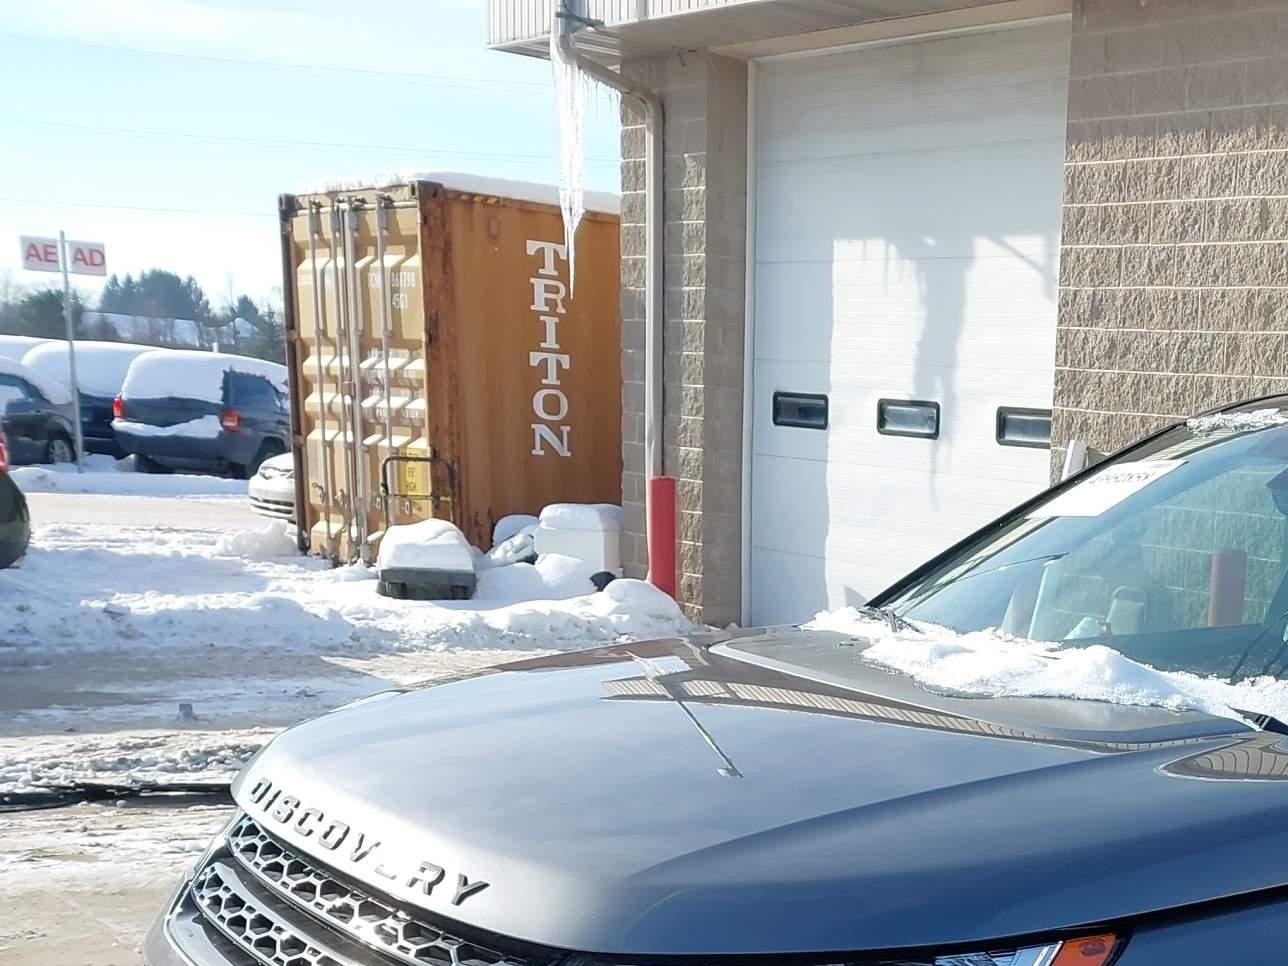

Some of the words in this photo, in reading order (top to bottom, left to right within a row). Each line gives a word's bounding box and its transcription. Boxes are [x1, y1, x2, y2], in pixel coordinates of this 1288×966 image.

[26, 242, 58, 263] AE
[72, 247, 105, 267] AD
[526, 239, 571, 457] TRITON
